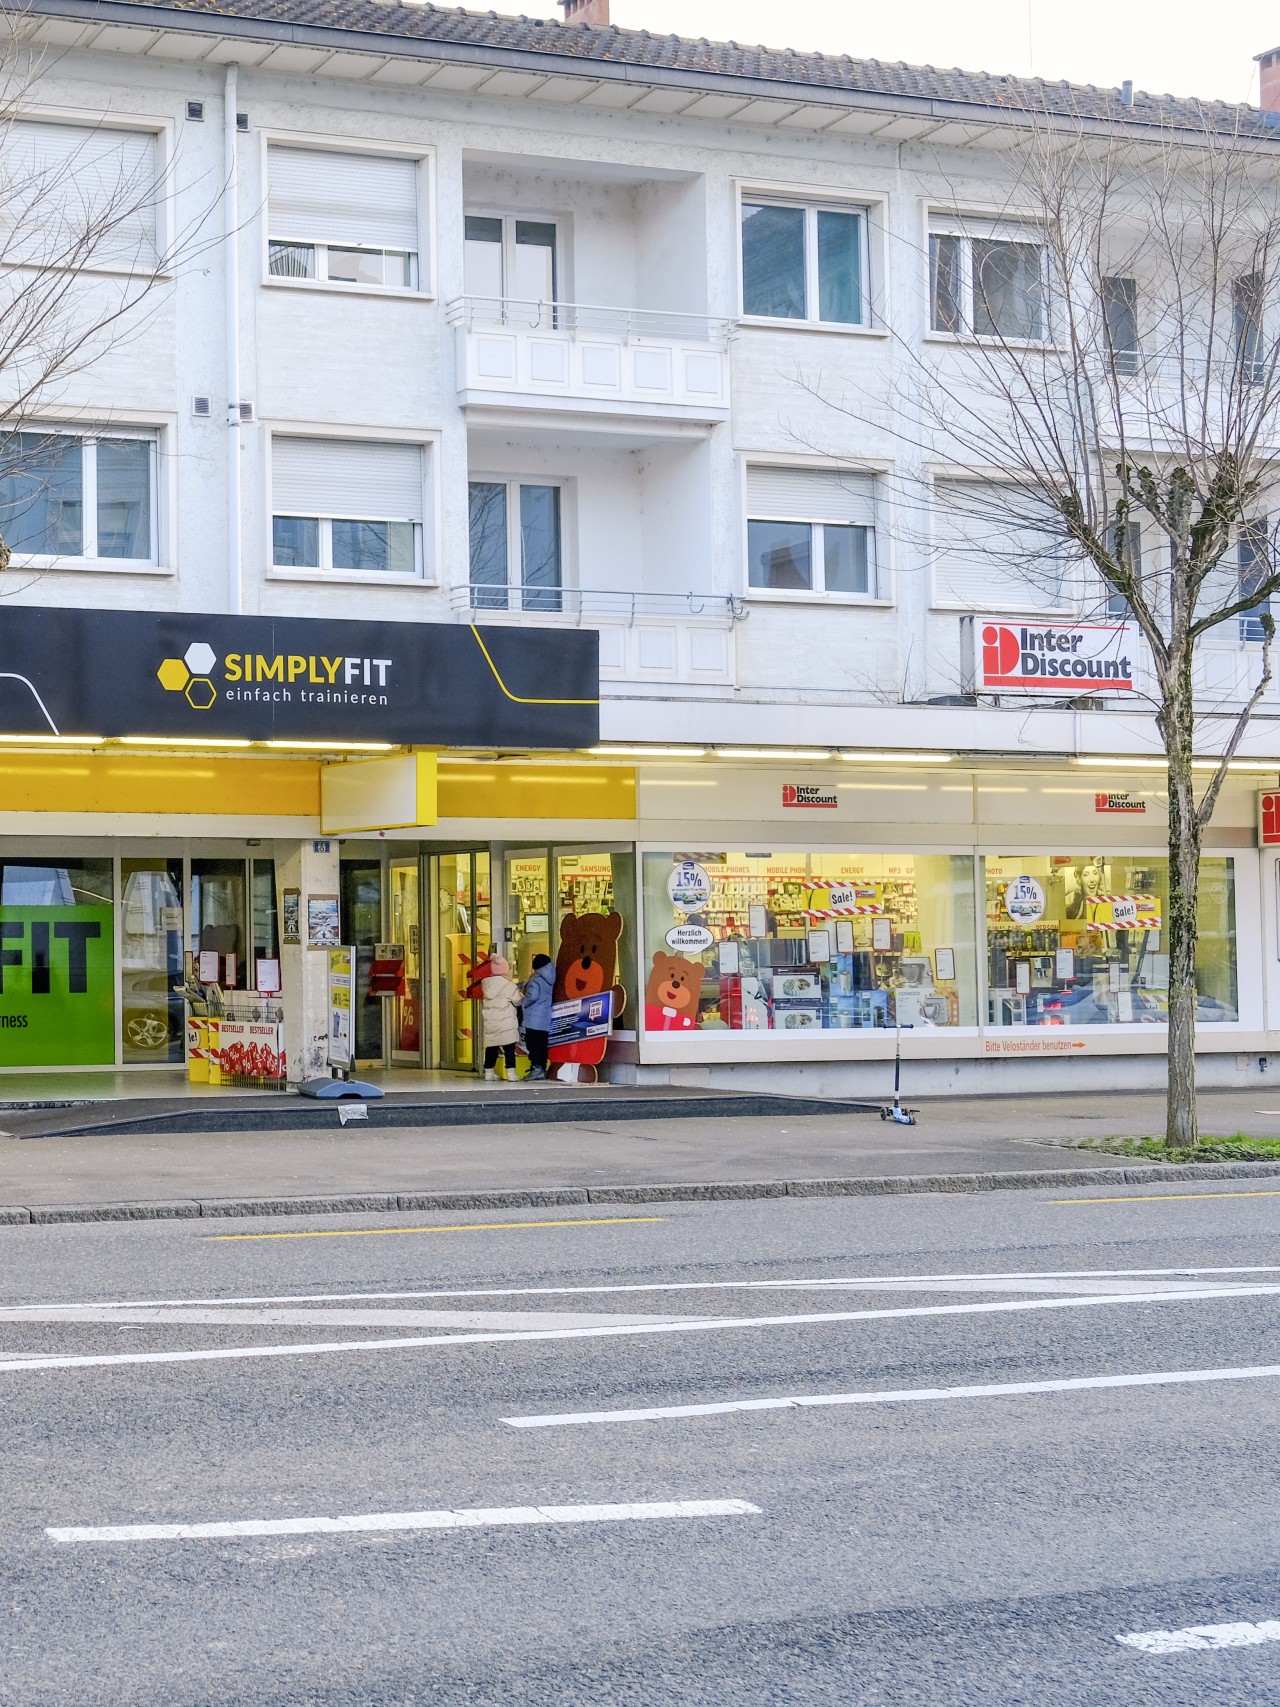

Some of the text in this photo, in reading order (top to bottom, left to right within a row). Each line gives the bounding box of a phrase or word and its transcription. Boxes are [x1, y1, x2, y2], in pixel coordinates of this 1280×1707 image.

[1021, 628, 1083, 653] Inter
[224, 653, 393, 687] SIMPLYFIT
[1021, 652, 1132, 679] Discount
[226, 687, 388, 706] einfach trainieren
[796, 786, 820, 795] Inter
[1108, 792, 1130, 800] Inter
[796, 794, 838, 804] Discount
[1108, 800, 1146, 809] Discount
[515, 864, 541, 872] ENERGY
[580, 865, 612, 873] SAMSUNG
[766, 866, 814, 874] MOBILE PHONS
[676, 871, 702, 887] 15%
[831, 891, 853, 905] Sale!
[1014, 885, 1037, 900] 15%
[1114, 904, 1134, 918] Sale!
[677, 929, 702, 937] Herzlich
[671, 937, 709, 945] willkommen!
[221, 1024, 274, 1035] BESTSELLER BESTSELLER
[985, 1040, 1072, 1052] Bitte Veloständer benutzen
